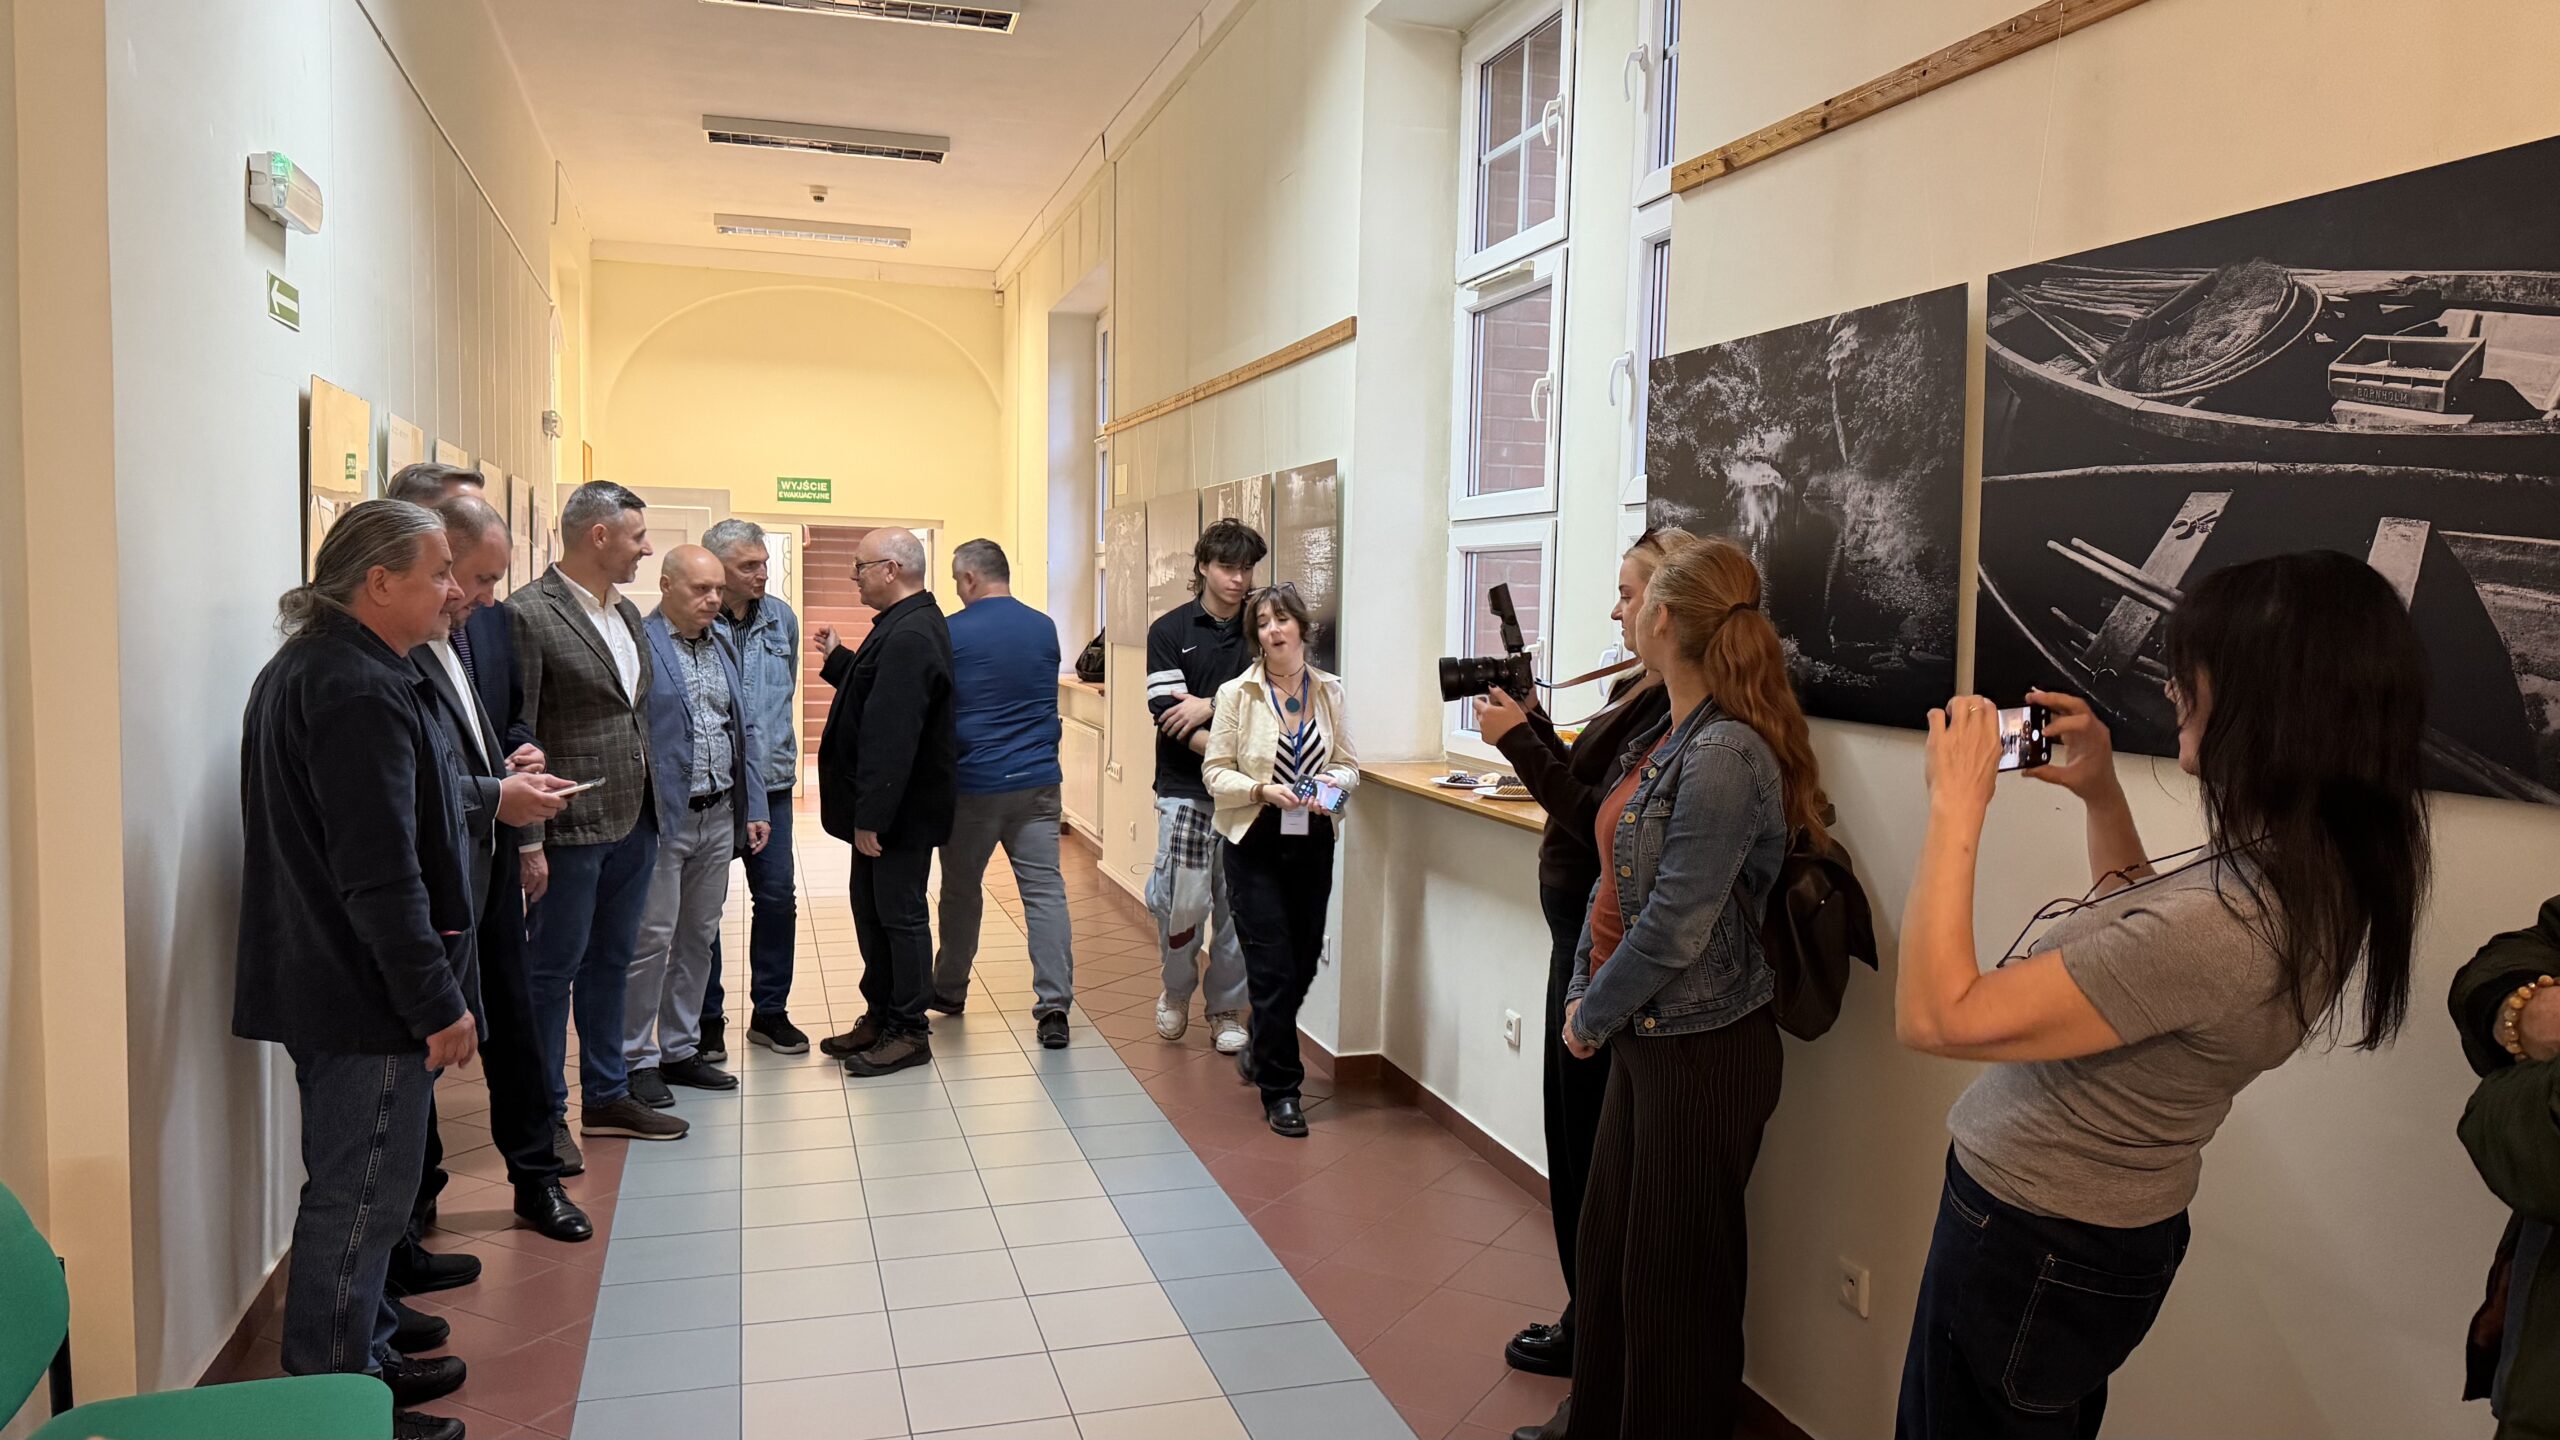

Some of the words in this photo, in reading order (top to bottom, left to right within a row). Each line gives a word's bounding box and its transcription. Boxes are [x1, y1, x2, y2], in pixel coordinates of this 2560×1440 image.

[2357, 387, 2408, 403] BORNHOLM
[780, 480, 828, 491] WYJŚCIE
[778, 491, 830, 500] EWAKUACYJNE
